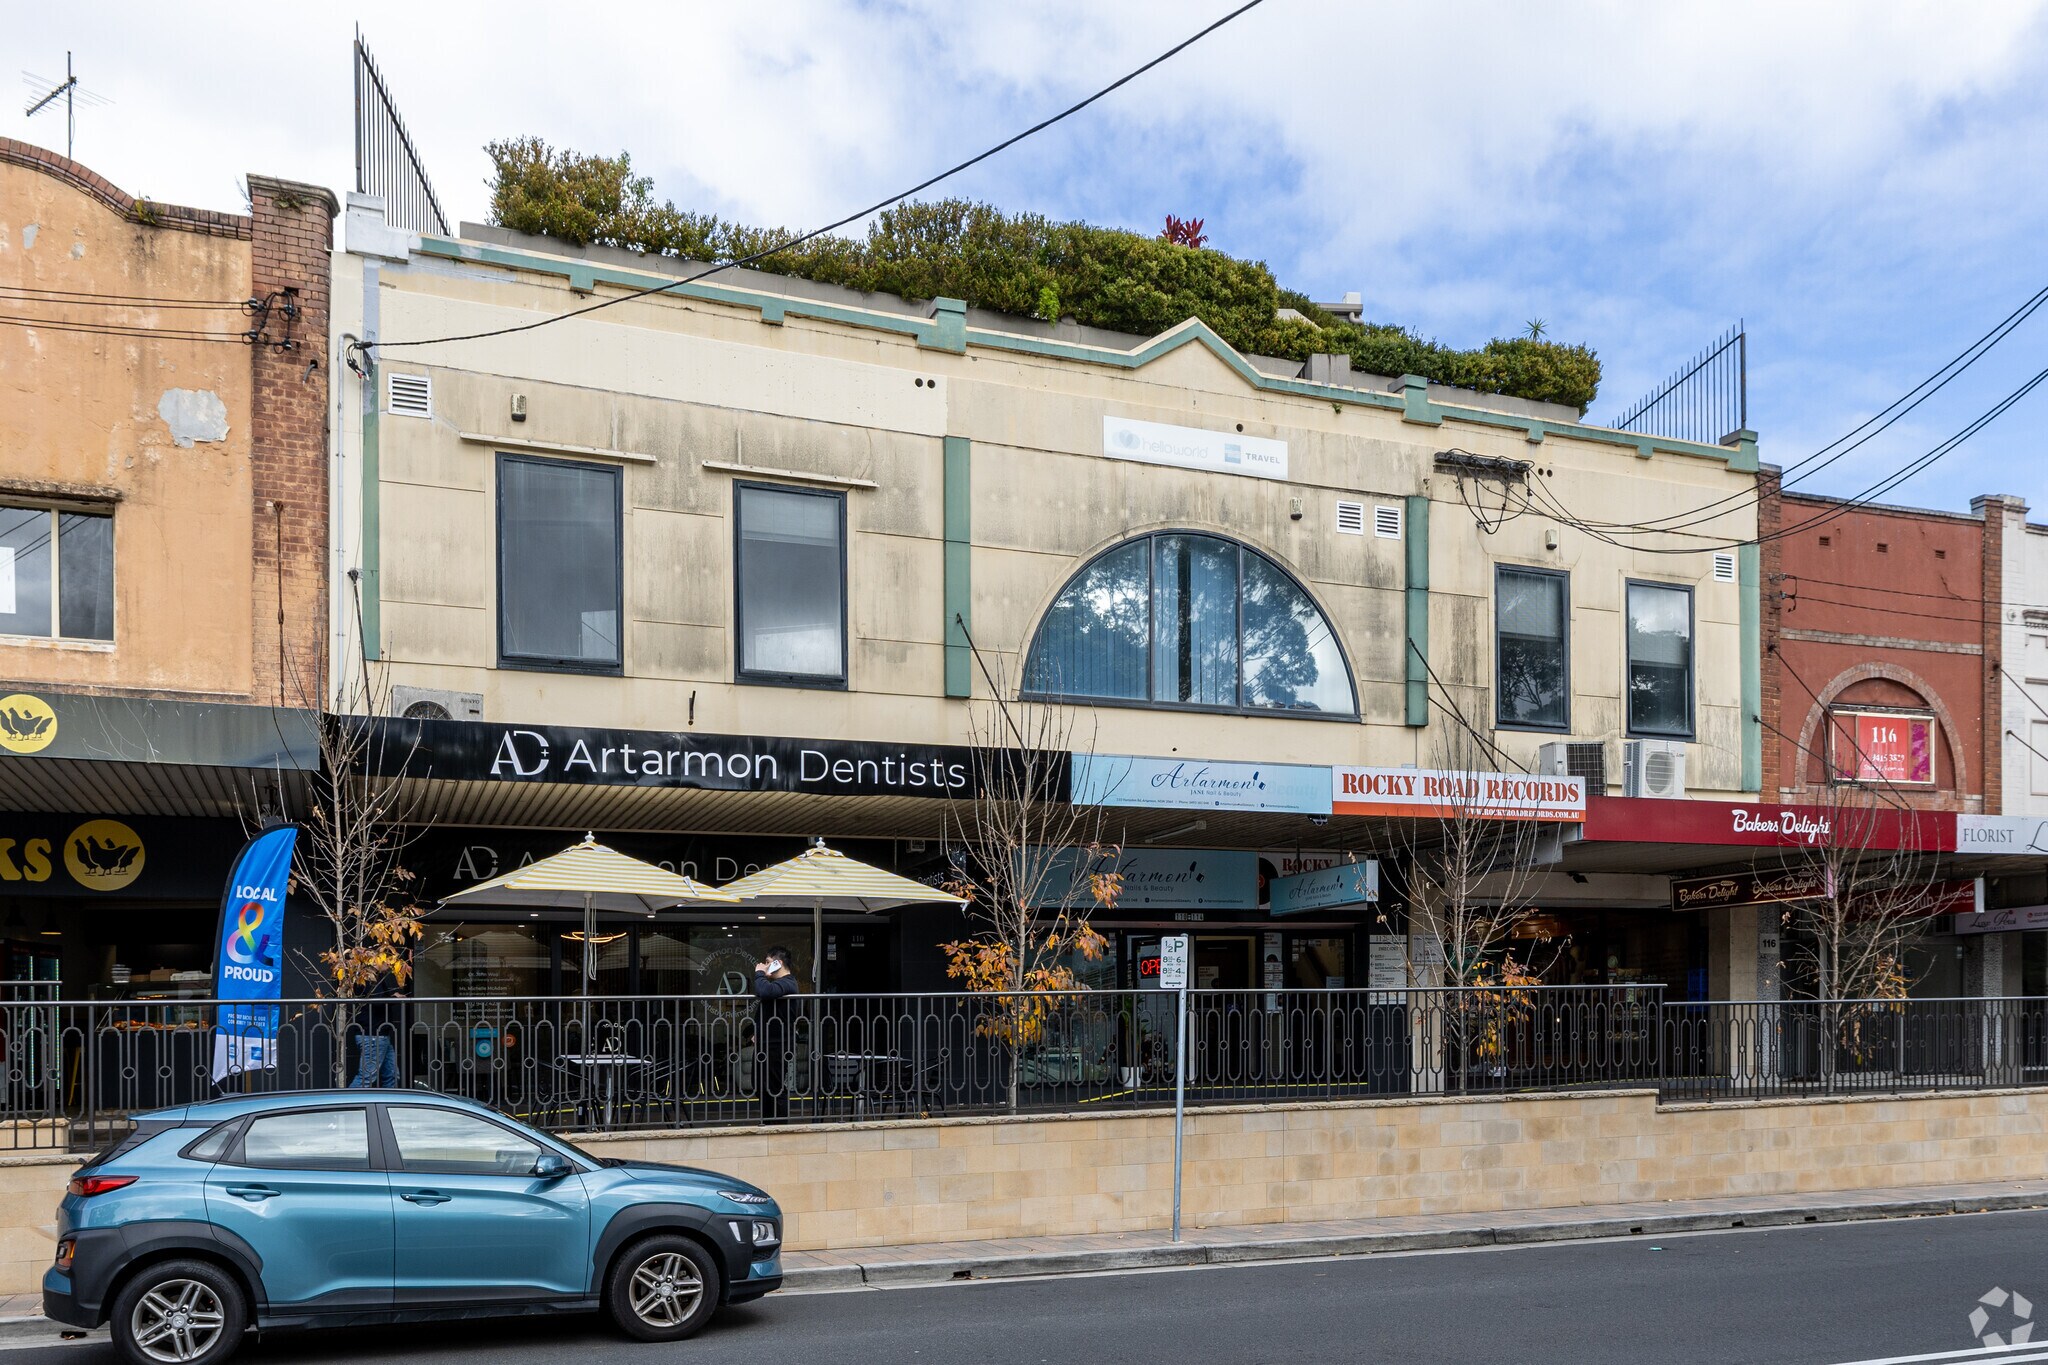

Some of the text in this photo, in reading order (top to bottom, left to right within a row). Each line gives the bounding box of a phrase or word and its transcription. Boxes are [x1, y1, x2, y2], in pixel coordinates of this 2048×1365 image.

[1245, 452, 1281, 465] TRAVEL
[1872, 726, 1897, 743] 116
[563, 738, 778, 780] Artarmon
[800, 749, 967, 789] Dentists
[1151, 762, 1254, 789] Artarmon
[1342, 773, 1580, 803] ROCKY ROAD RECORDS
[1731, 809, 1831, 844] Bakers Delight
[1963, 828, 2015, 843] FLORIST
[1069, 854, 1191, 883] Atarmon
[1150, 884, 1174, 893] Beauty
[1784, 876, 1817, 893] Delight
[236, 885, 278, 902] LOCAL
[1678, 885, 1739, 903] Bakers Delight
[226, 901, 274, 967] &
[1762, 938, 1777, 948] 116
[224, 966, 274, 983] PROUD
[1140, 958, 1161, 975] OPE
